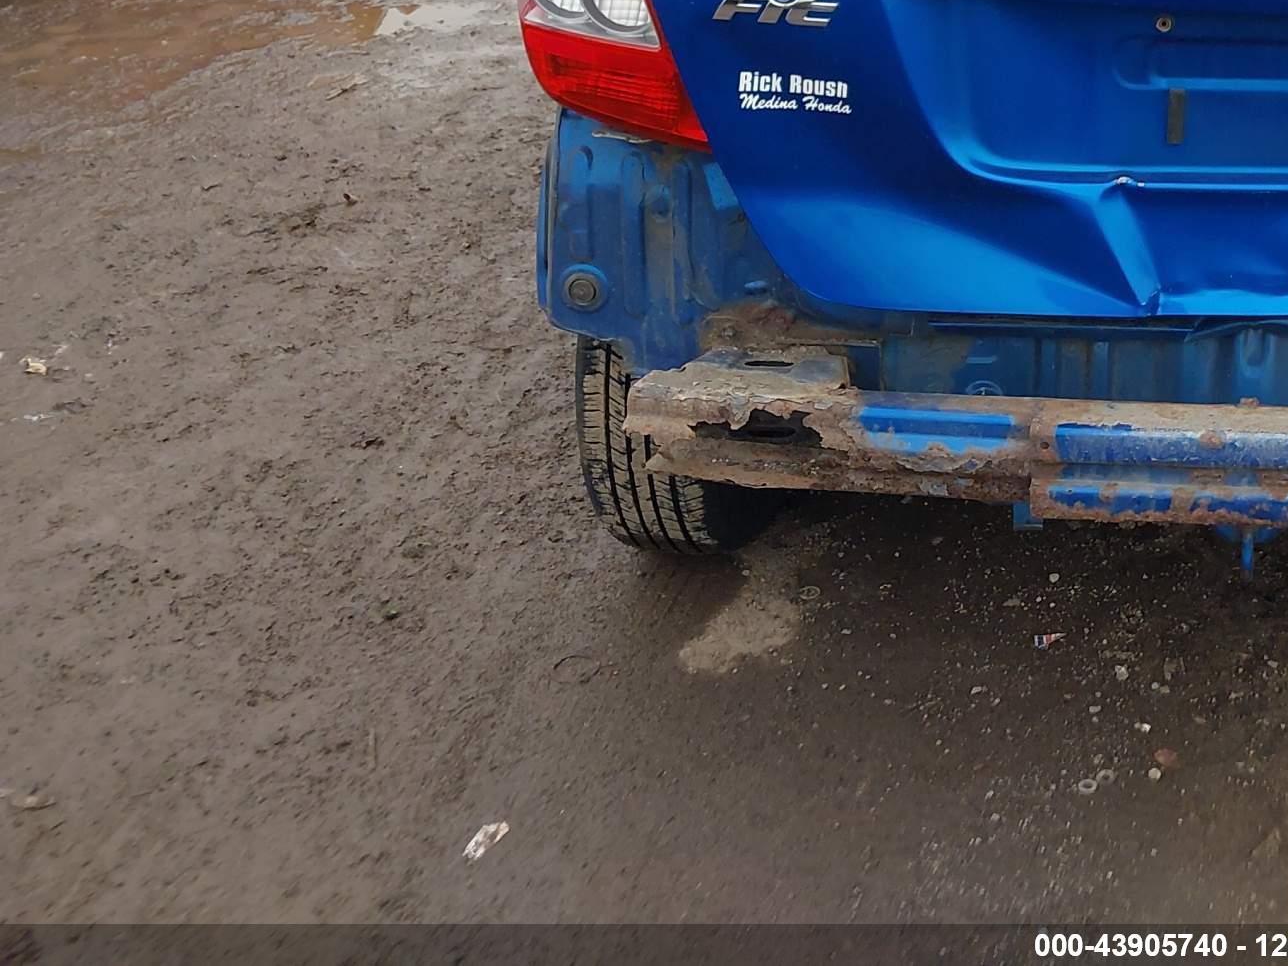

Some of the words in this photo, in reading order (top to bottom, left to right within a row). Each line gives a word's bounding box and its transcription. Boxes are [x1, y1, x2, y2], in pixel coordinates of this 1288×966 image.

[738, 71, 782, 93] Rick
[739, 94, 799, 111] Medina
[801, 96, 852, 114] Honda
